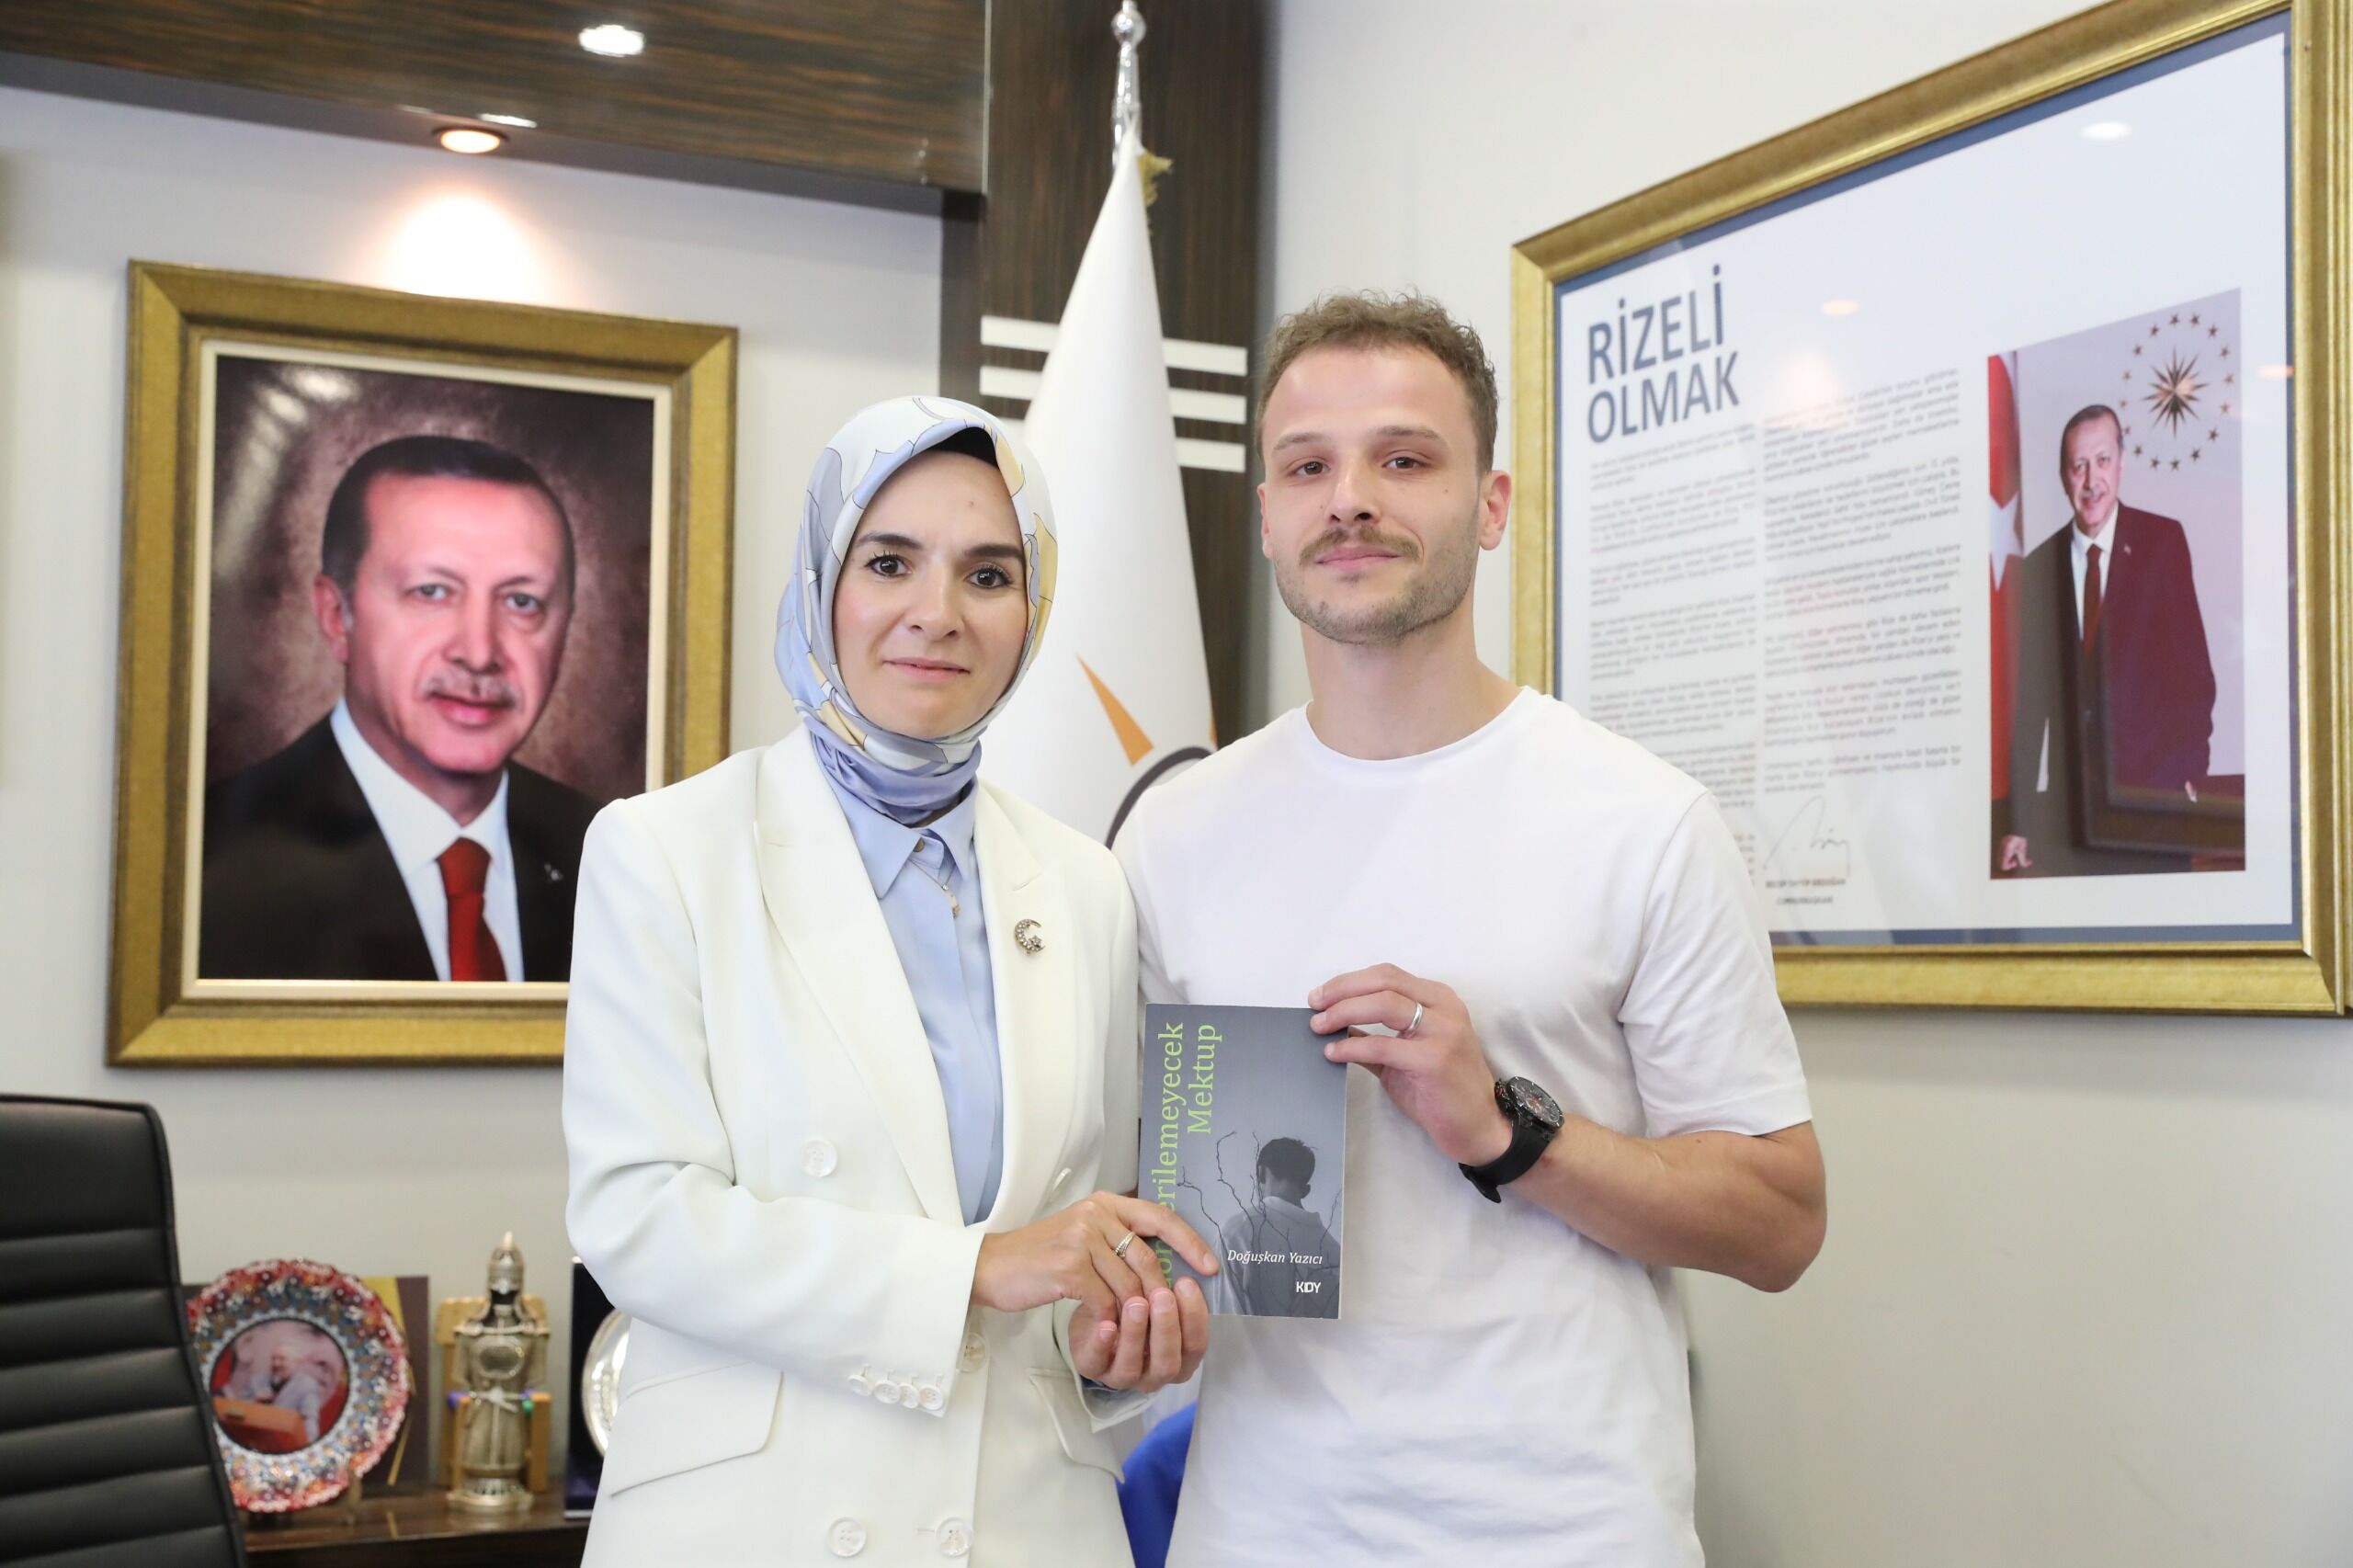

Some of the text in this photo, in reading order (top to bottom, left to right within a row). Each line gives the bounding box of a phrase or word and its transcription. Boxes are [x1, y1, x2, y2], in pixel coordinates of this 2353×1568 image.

[1588, 263, 1723, 384] RİZELİ
[1588, 350, 1740, 444] OLMAK
[1188, 1024, 1222, 1135] Mektup
[1152, 1022, 1188, 1289] nerilemeyecek
[1228, 1250, 1323, 1265] Doğuşkan Yazıcı
